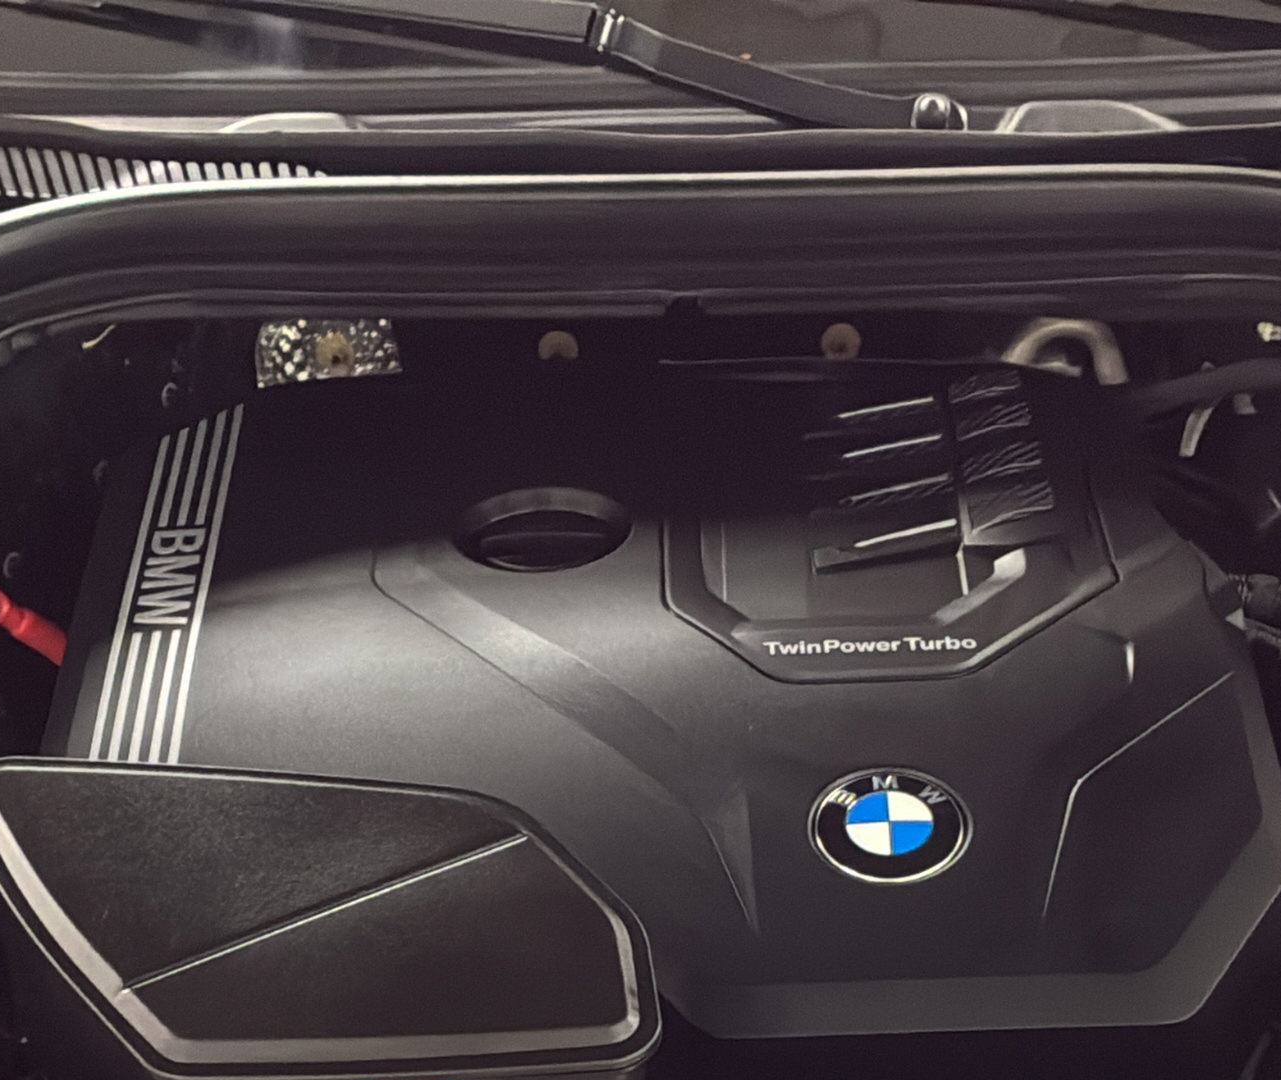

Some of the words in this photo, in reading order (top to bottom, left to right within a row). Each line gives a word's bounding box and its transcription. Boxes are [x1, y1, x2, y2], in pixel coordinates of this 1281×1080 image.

[133, 527, 206, 625] BMW
[762, 638, 901, 656] TwinPower
[903, 635, 978, 651] Turbo
[828, 774, 948, 806] BMW
